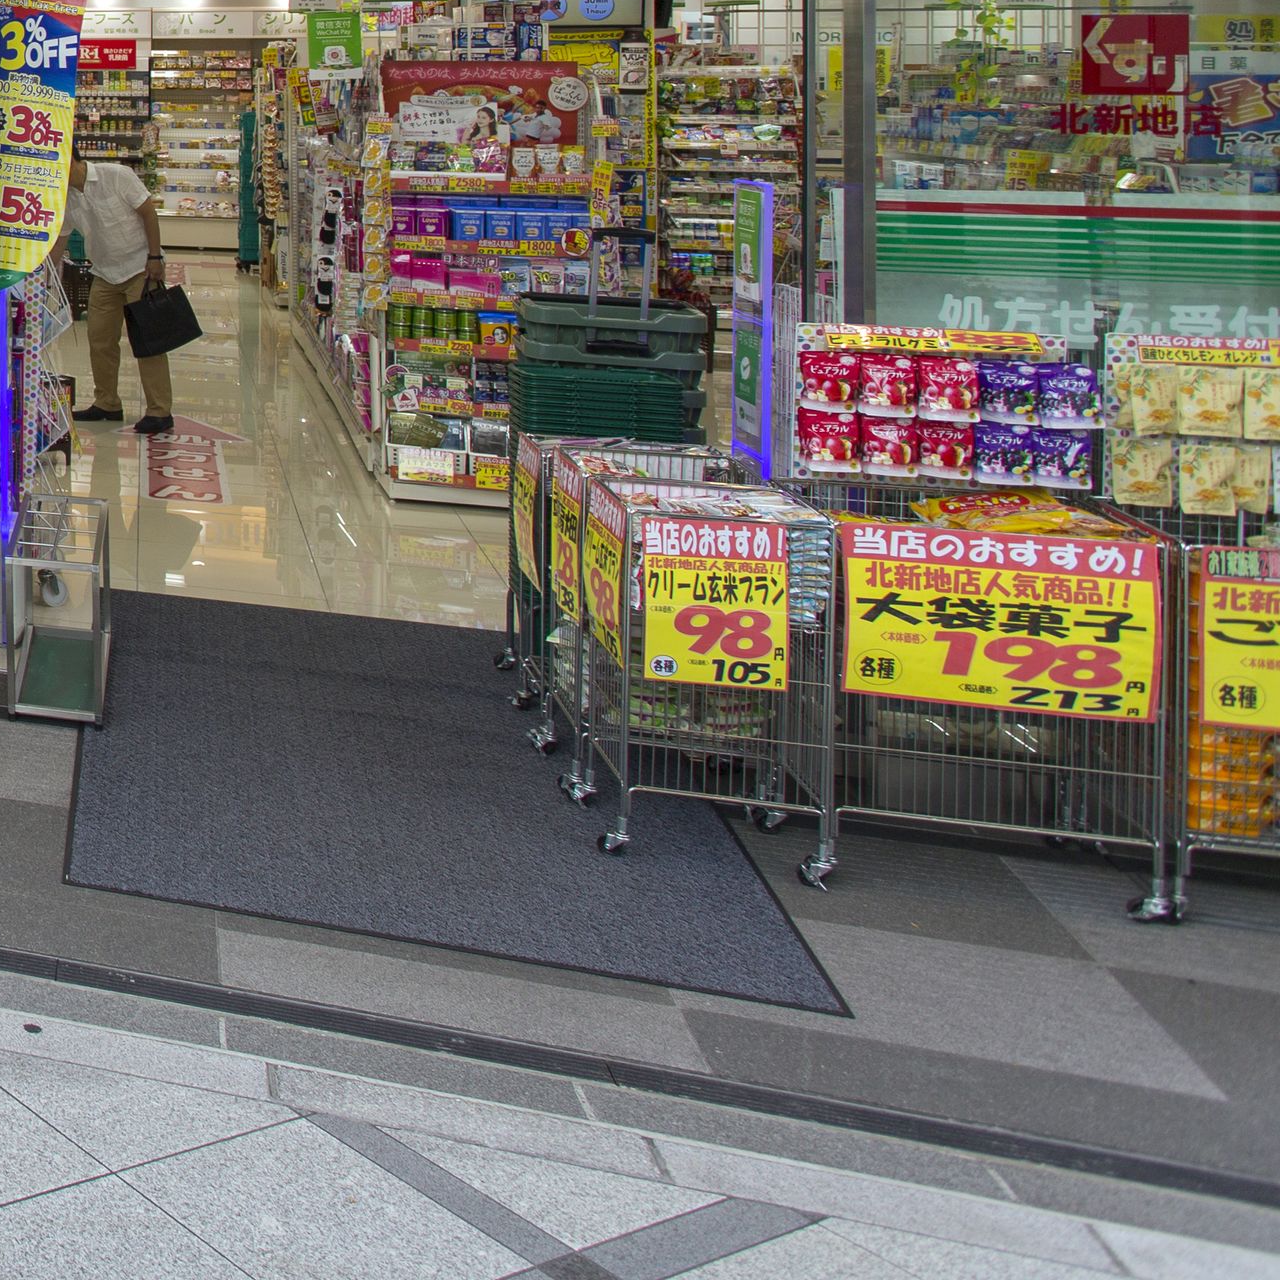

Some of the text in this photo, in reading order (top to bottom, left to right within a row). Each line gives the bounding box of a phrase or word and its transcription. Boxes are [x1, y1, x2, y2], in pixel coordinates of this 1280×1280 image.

[32, 0, 78, 16] Tax-free
[316, 21, 352, 29] 微信支付
[340, 29, 352, 37] Pay
[26, 35, 78, 70] OFF
[79, 47, 100, 60] R-1
[107, 54, 129, 62] 乳酸菌
[1201, 56, 1248, 70] 目薬
[1050, 102, 1224, 137] 北新地店
[30, 126, 64, 148] OFF
[455, 178, 483, 187] 2580
[593, 188, 605, 201] 15
[592, 200, 608, 210] OFF
[21, 208, 55, 228] OFF
[523, 240, 552, 250] 1800
[823, 324, 943, 338] 当店のおすすめ!
[1138, 335, 1268, 350] 当店のおすすめ!
[1141, 347, 1257, 364] 国産ひとくちレモン・オレンジ
[809, 364, 850, 376] ピュアラル
[928, 372, 968, 384] ピュアラル
[985, 374, 1028, 386] ピュアラル
[1047, 378, 1088, 389] ピュアラル
[811, 423, 850, 434] ピュアラル
[922, 428, 965, 441] ピュアラル
[981, 434, 1024, 446] ピュアラル
[1038, 437, 1081, 450] ピュアラル
[645, 521, 784, 559] 当店のおすすめ!
[852, 526, 1145, 577] 当店のおすすめ!
[648, 556, 783, 575] 北新地店人気商品!!
[648, 570, 785, 606] クリーム玄米ブラン
[865, 561, 1132, 609] 北新地店人気商品!!
[590, 567, 616, 632] 98
[855, 591, 1148, 643] 大袋菓子
[674, 604, 785, 661] 98 円
[652, 659, 675, 673] 各種
[860, 655, 896, 680] 各種
[934, 631, 1146, 694] 198 円
[711, 659, 783, 687] 105 円
[1008, 685, 1140, 717] 213 円
[1219, 684, 1258, 710] 各種
